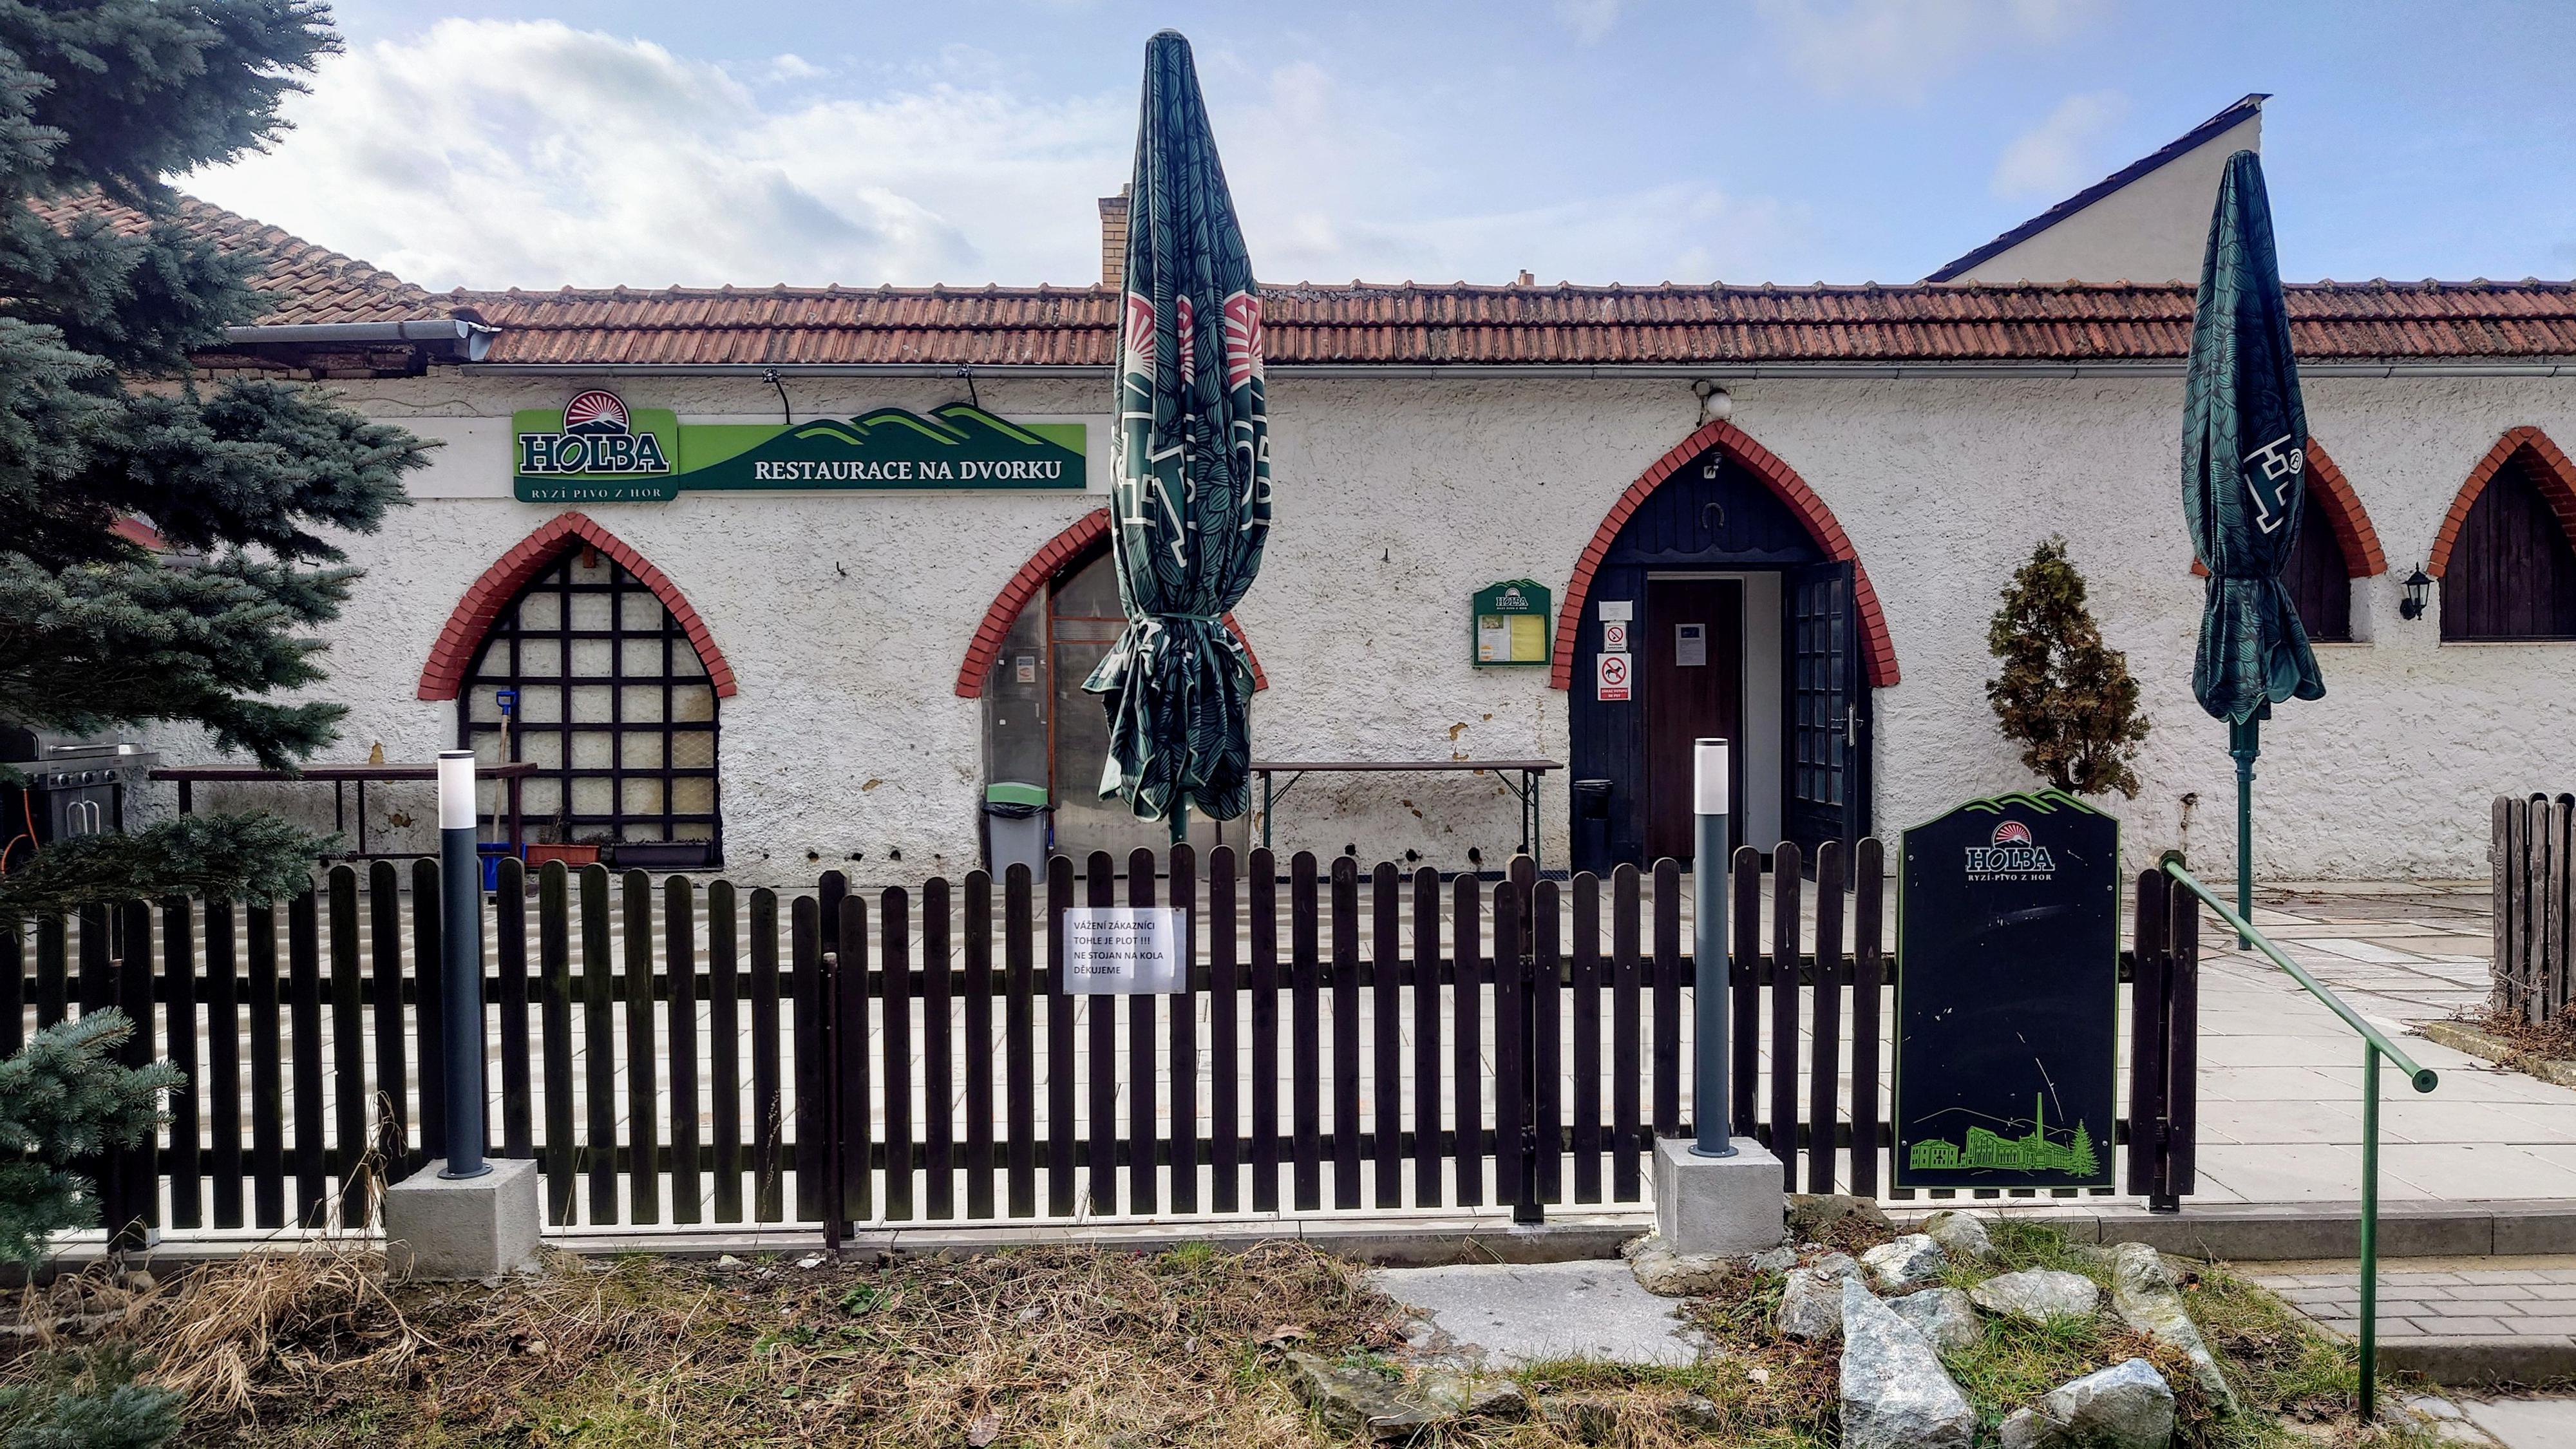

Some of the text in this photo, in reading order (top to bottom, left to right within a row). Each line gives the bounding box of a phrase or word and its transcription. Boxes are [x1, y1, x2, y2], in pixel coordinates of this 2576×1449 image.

[518, 433, 670, 474] HOLBA
[754, 461, 1062, 480] RESTAURACE NA DVORKU
[531, 487, 661, 498] RYZÍ PIVO Z HOR
[1495, 596, 1529, 607] HOLBA
[1965, 846, 2056, 872] HOLBA
[1968, 873, 1991, 881] RYZÍ
[1074, 920, 1155, 930] VÁŽENÍ ZÁKAZNÍCI
[1104, 937, 1113, 945] JE
[1074, 965, 1121, 974] DĚKUJEME
